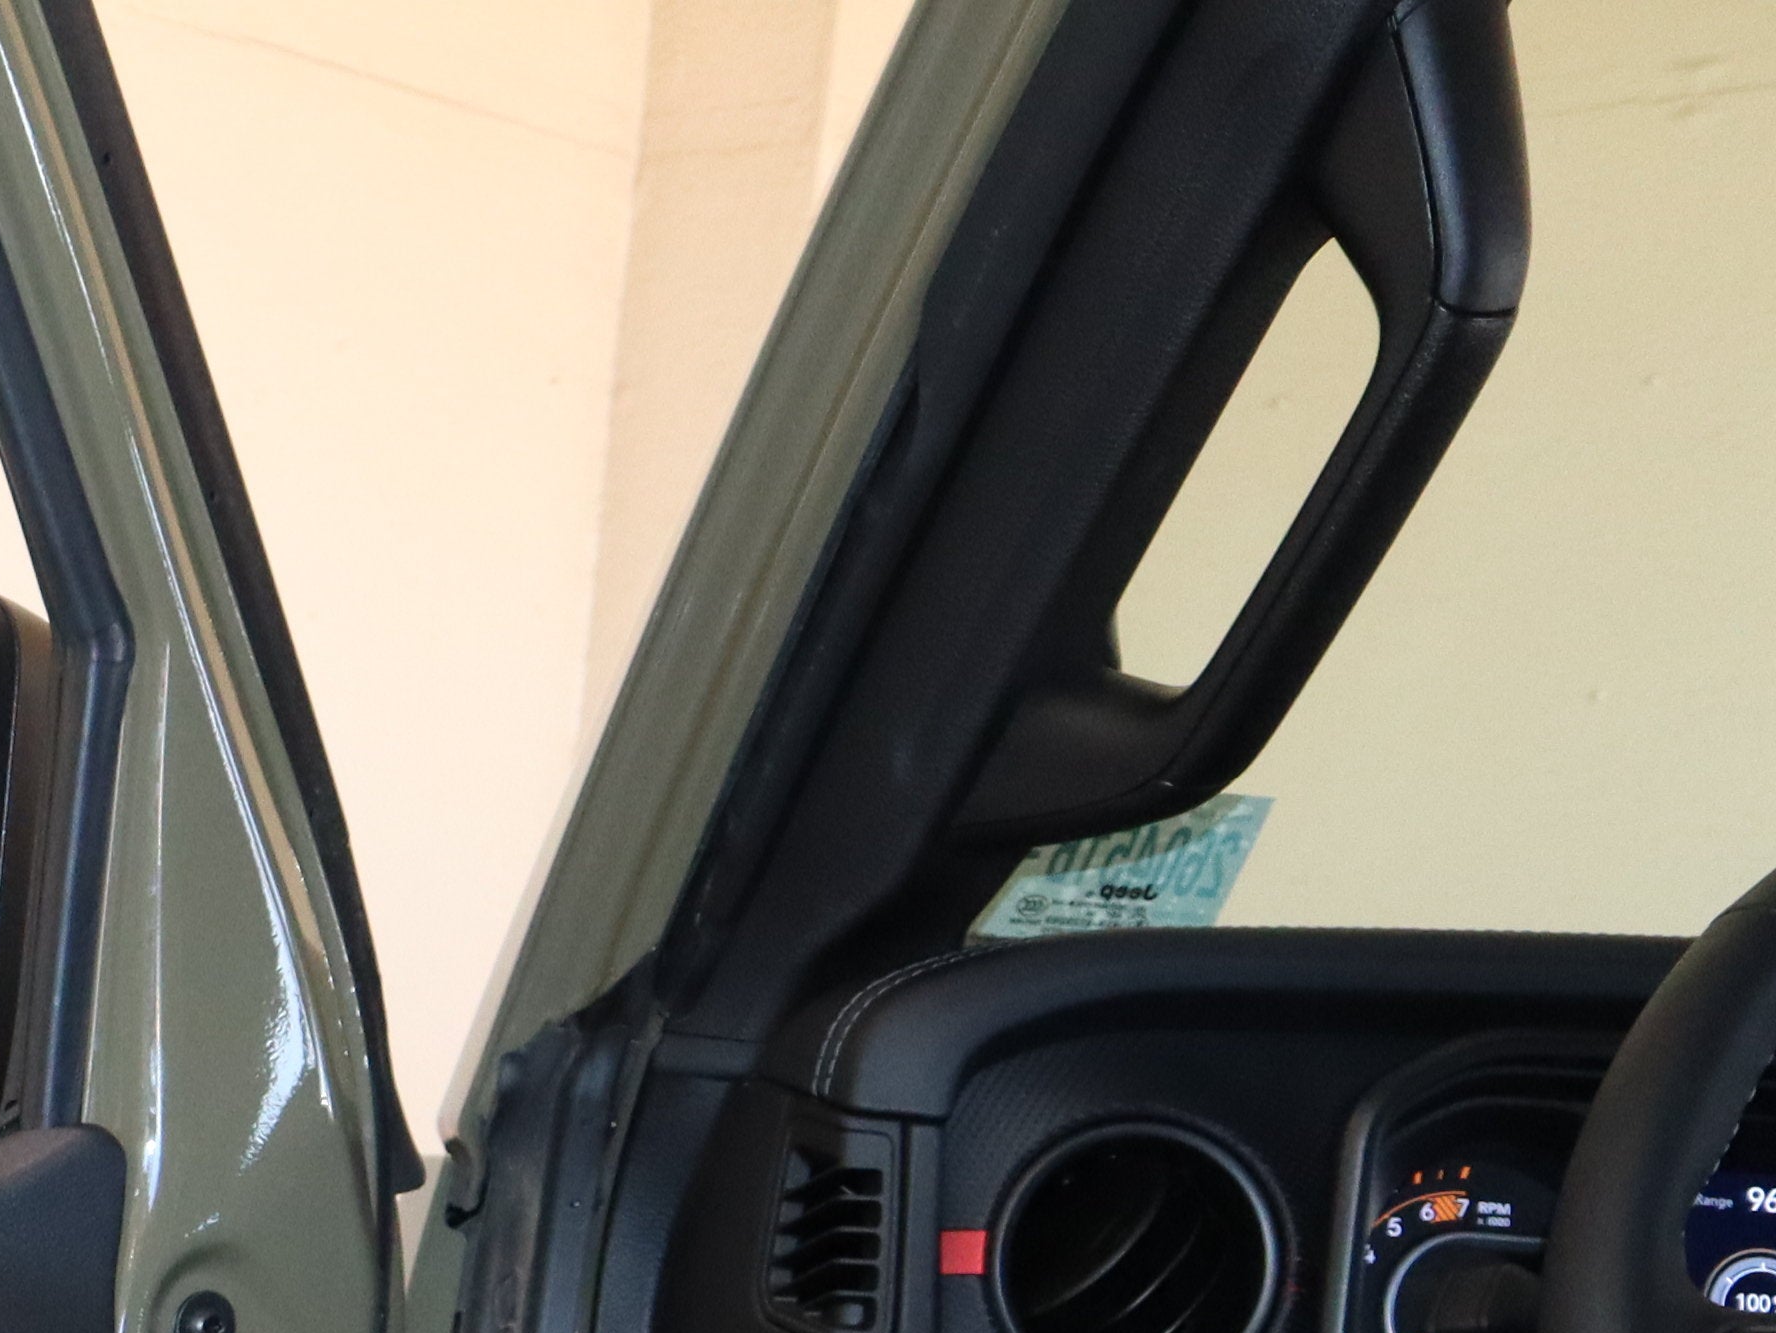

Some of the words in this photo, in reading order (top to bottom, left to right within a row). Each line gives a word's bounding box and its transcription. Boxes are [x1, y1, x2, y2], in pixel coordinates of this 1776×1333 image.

[1419, 1202, 1435, 1221] 6
[1455, 1198, 1471, 1218] 7
[1476, 1200, 1511, 1216] RPM
[1387, 1217, 1403, 1237] 5
